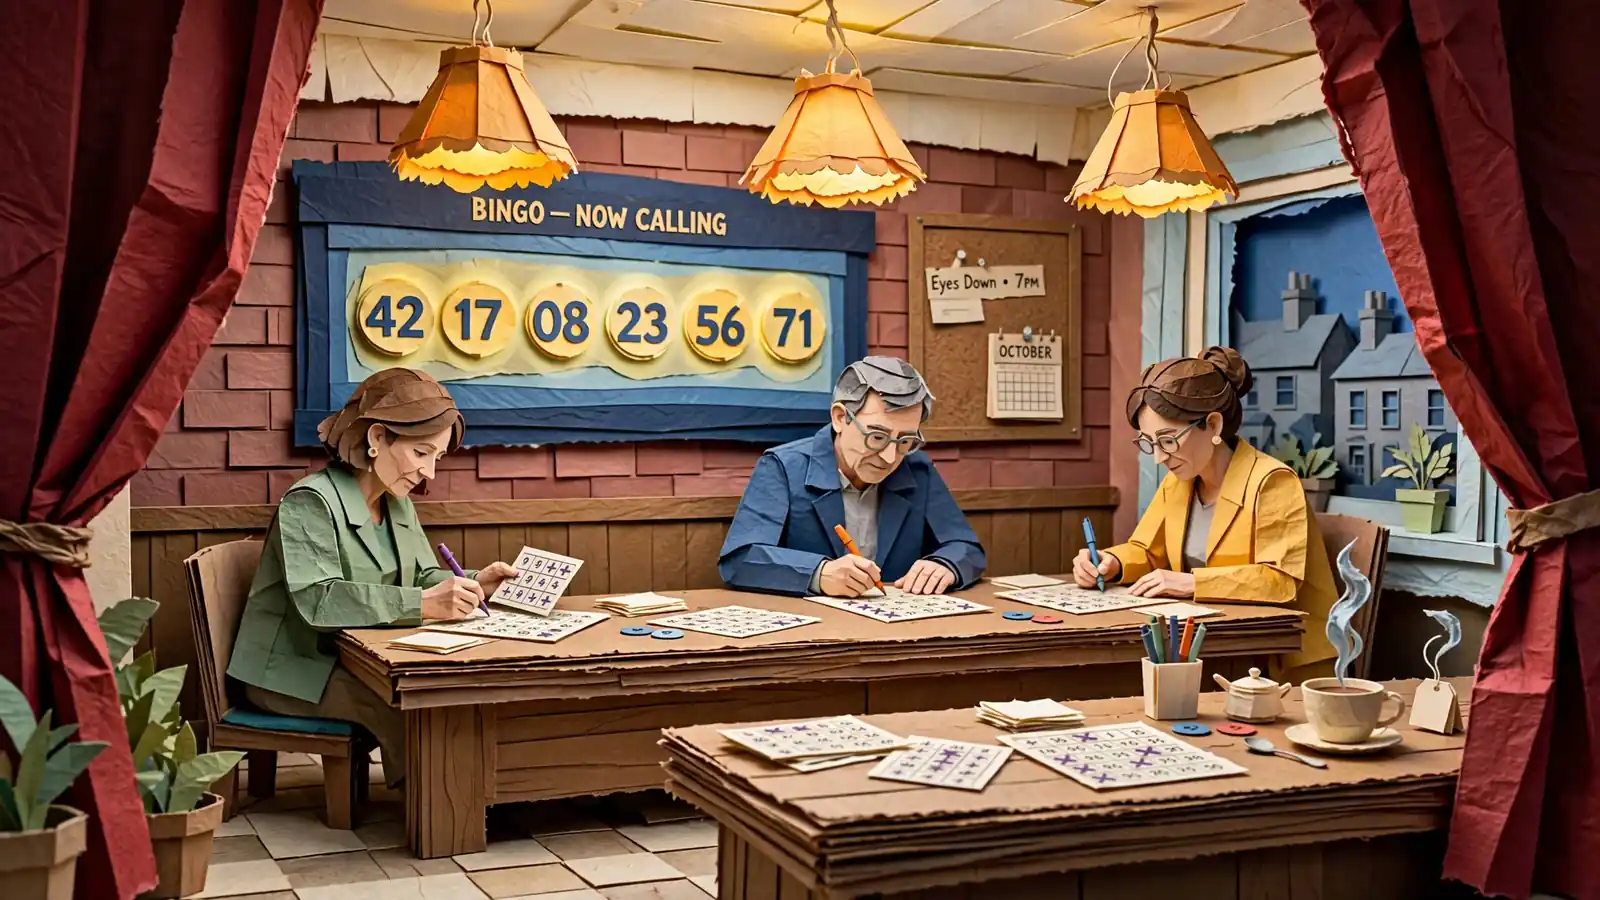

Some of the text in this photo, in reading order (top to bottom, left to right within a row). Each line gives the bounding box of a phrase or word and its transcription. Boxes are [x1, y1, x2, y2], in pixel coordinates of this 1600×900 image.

[472, 196, 545, 225] BINGO
[576, 203, 628, 229] NOW
[635, 208, 727, 236] CALLING
[931, 275, 959, 295] Eyes
[964, 274, 996, 290] Down
[1015, 273, 1039, 288] 7PM
[365, 295, 812, 348] 42 17 08 23 56 71
[999, 345, 1052, 359] OCTOBER
